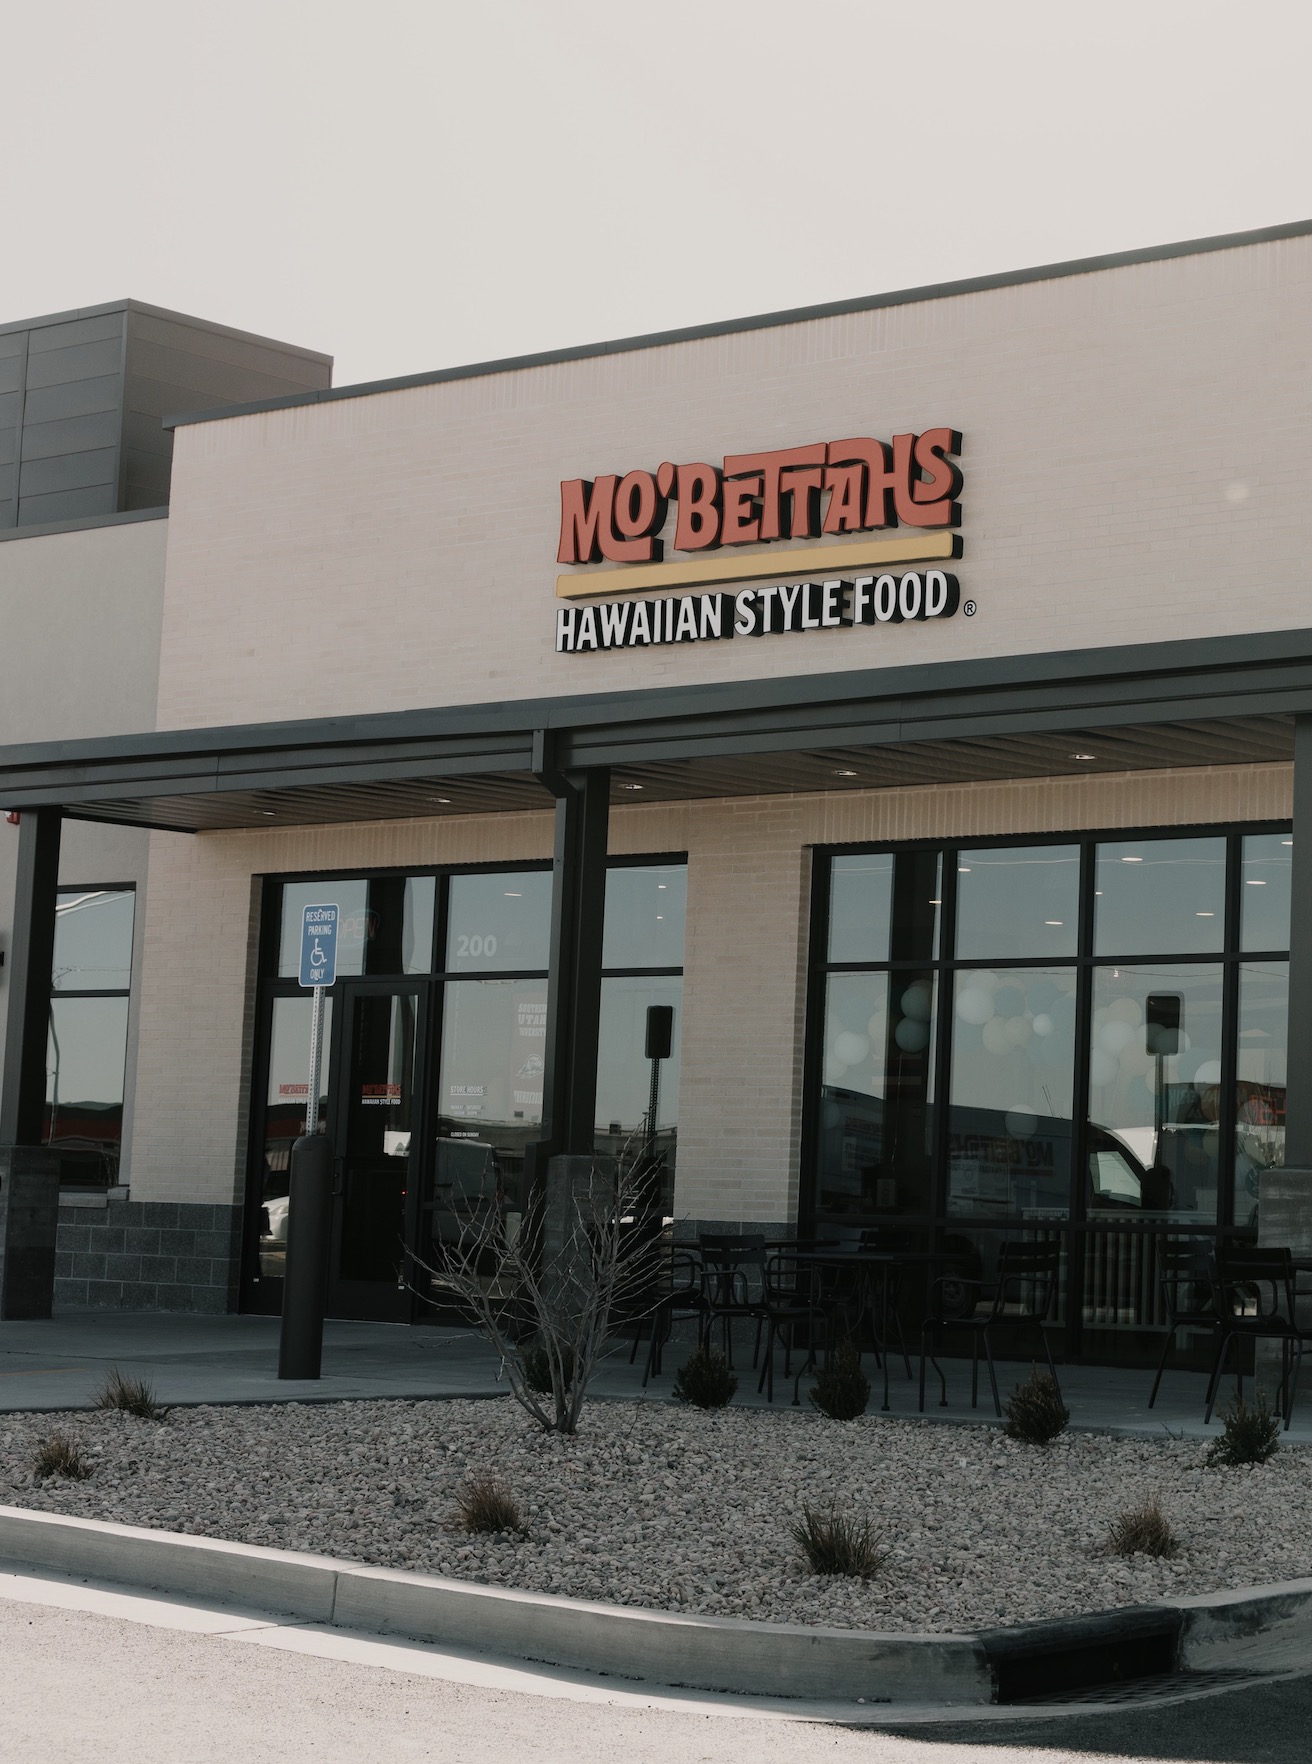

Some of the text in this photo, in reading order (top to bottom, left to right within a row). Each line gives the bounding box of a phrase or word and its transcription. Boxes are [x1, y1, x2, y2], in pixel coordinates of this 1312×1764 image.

[556, 592, 731, 653] HAWAIIAN
[735, 580, 848, 636] STYLE
[855, 570, 956, 625] FOOD
[306, 911, 336, 922] RESERVED
[308, 925, 332, 936] PARKING
[457, 935, 497, 957] 200
[310, 968, 325, 979] ONLY
[450, 1085, 483, 1094] STORE HOURS
